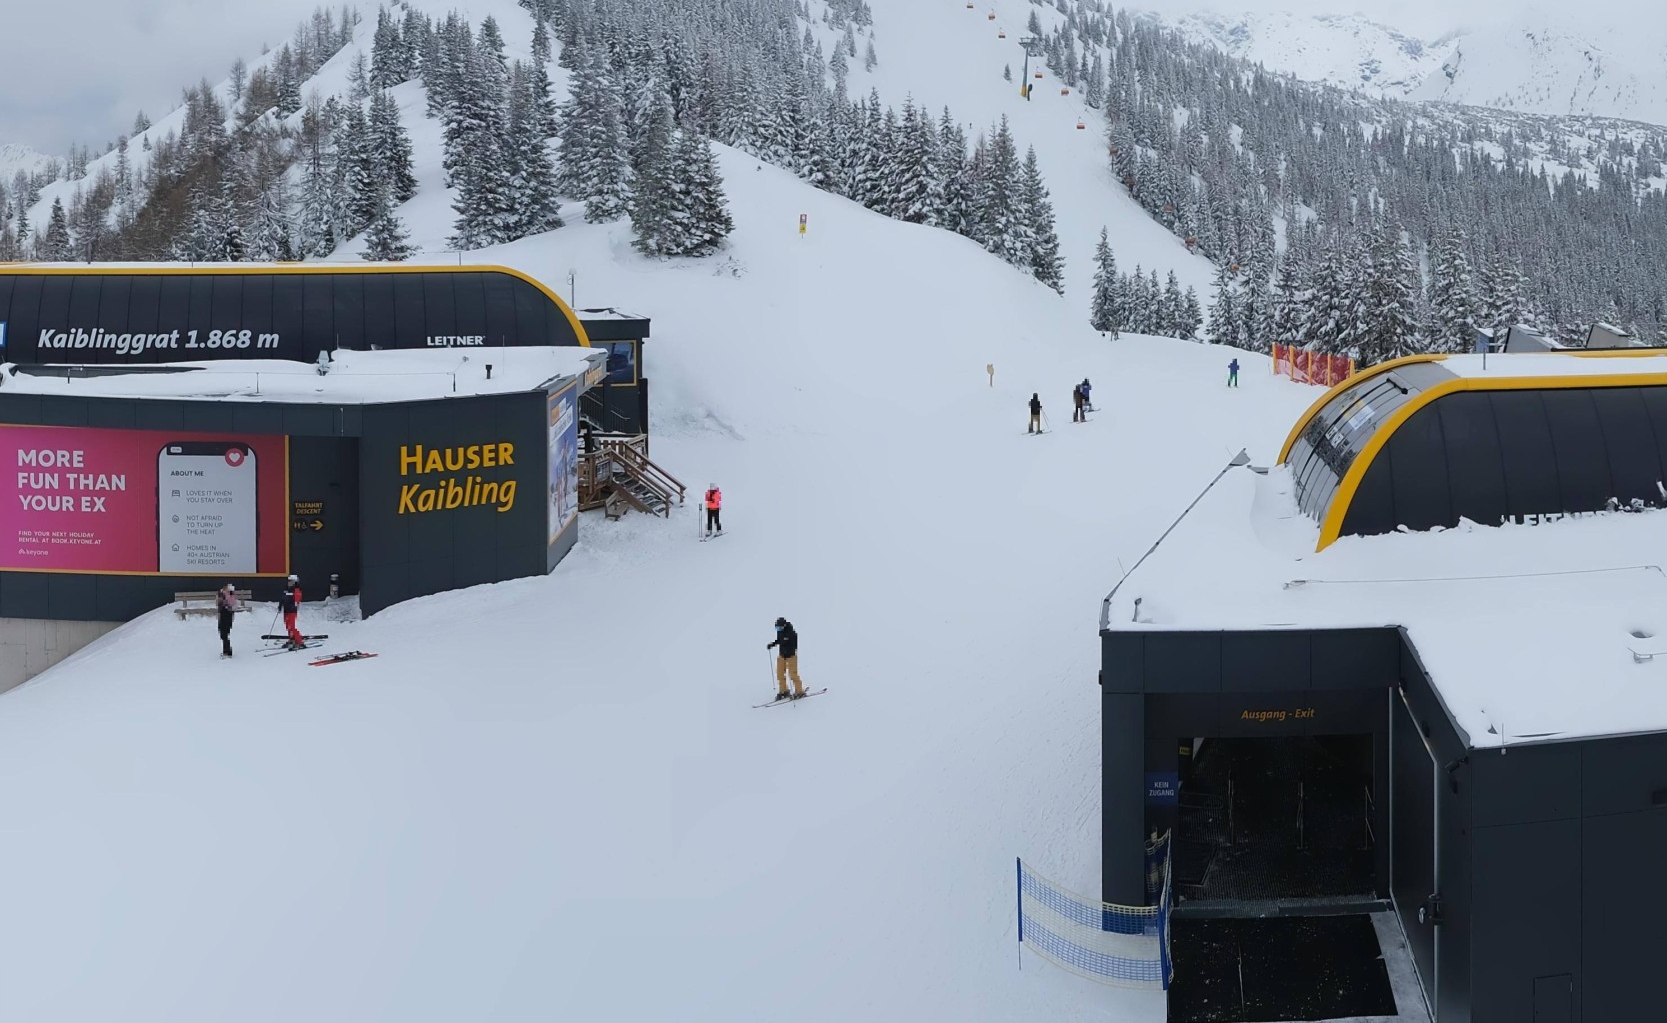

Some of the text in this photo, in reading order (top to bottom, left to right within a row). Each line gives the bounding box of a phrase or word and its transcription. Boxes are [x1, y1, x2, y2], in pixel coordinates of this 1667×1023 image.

[38, 328, 279, 354] Kaiblinggrat 1.868 m
[427, 336, 484, 345] LEITNER
[17, 449, 84, 468] MORE
[400, 442, 515, 475] HAUSER
[17, 472, 126, 491] FUN THAN
[19, 495, 106, 512] YOUR EX
[398, 476, 517, 514] Kaibling
[1241, 709, 1286, 721] Ausgang
[1295, 708, 1315, 718] Exit
